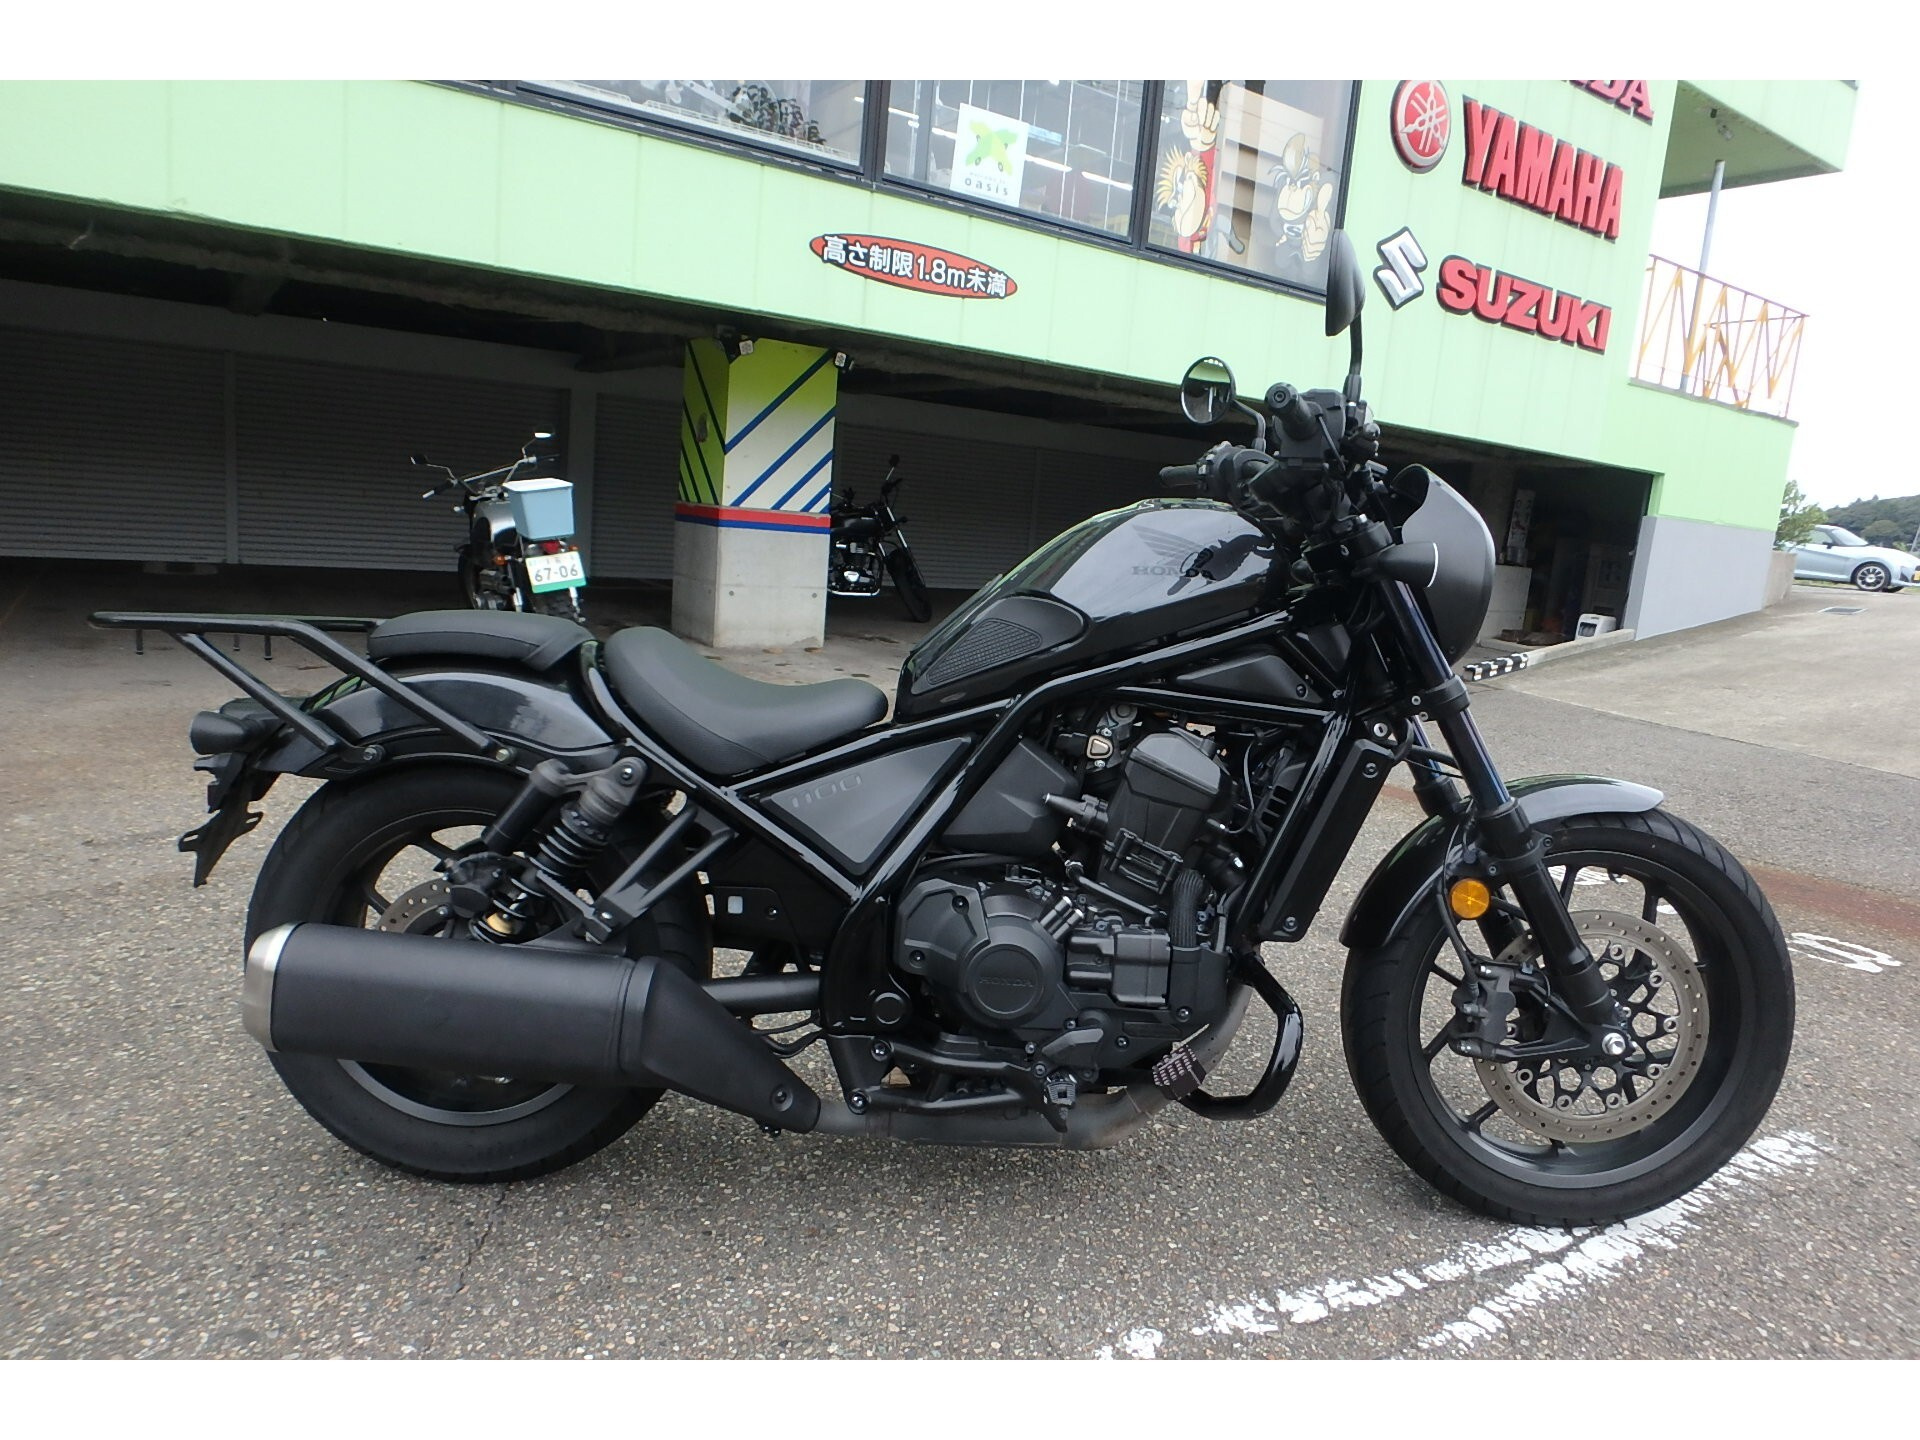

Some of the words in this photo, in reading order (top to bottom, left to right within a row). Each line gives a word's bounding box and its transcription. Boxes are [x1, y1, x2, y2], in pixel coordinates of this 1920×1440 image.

[964, 177, 1008, 196] oasis
[1463, 97, 1623, 241] YAMAHA
[822, 235, 1008, 297] 高さ制限1.8m未満
[1437, 255, 1612, 353] SUZUKI
[534, 563, 579, 583] 67-06
